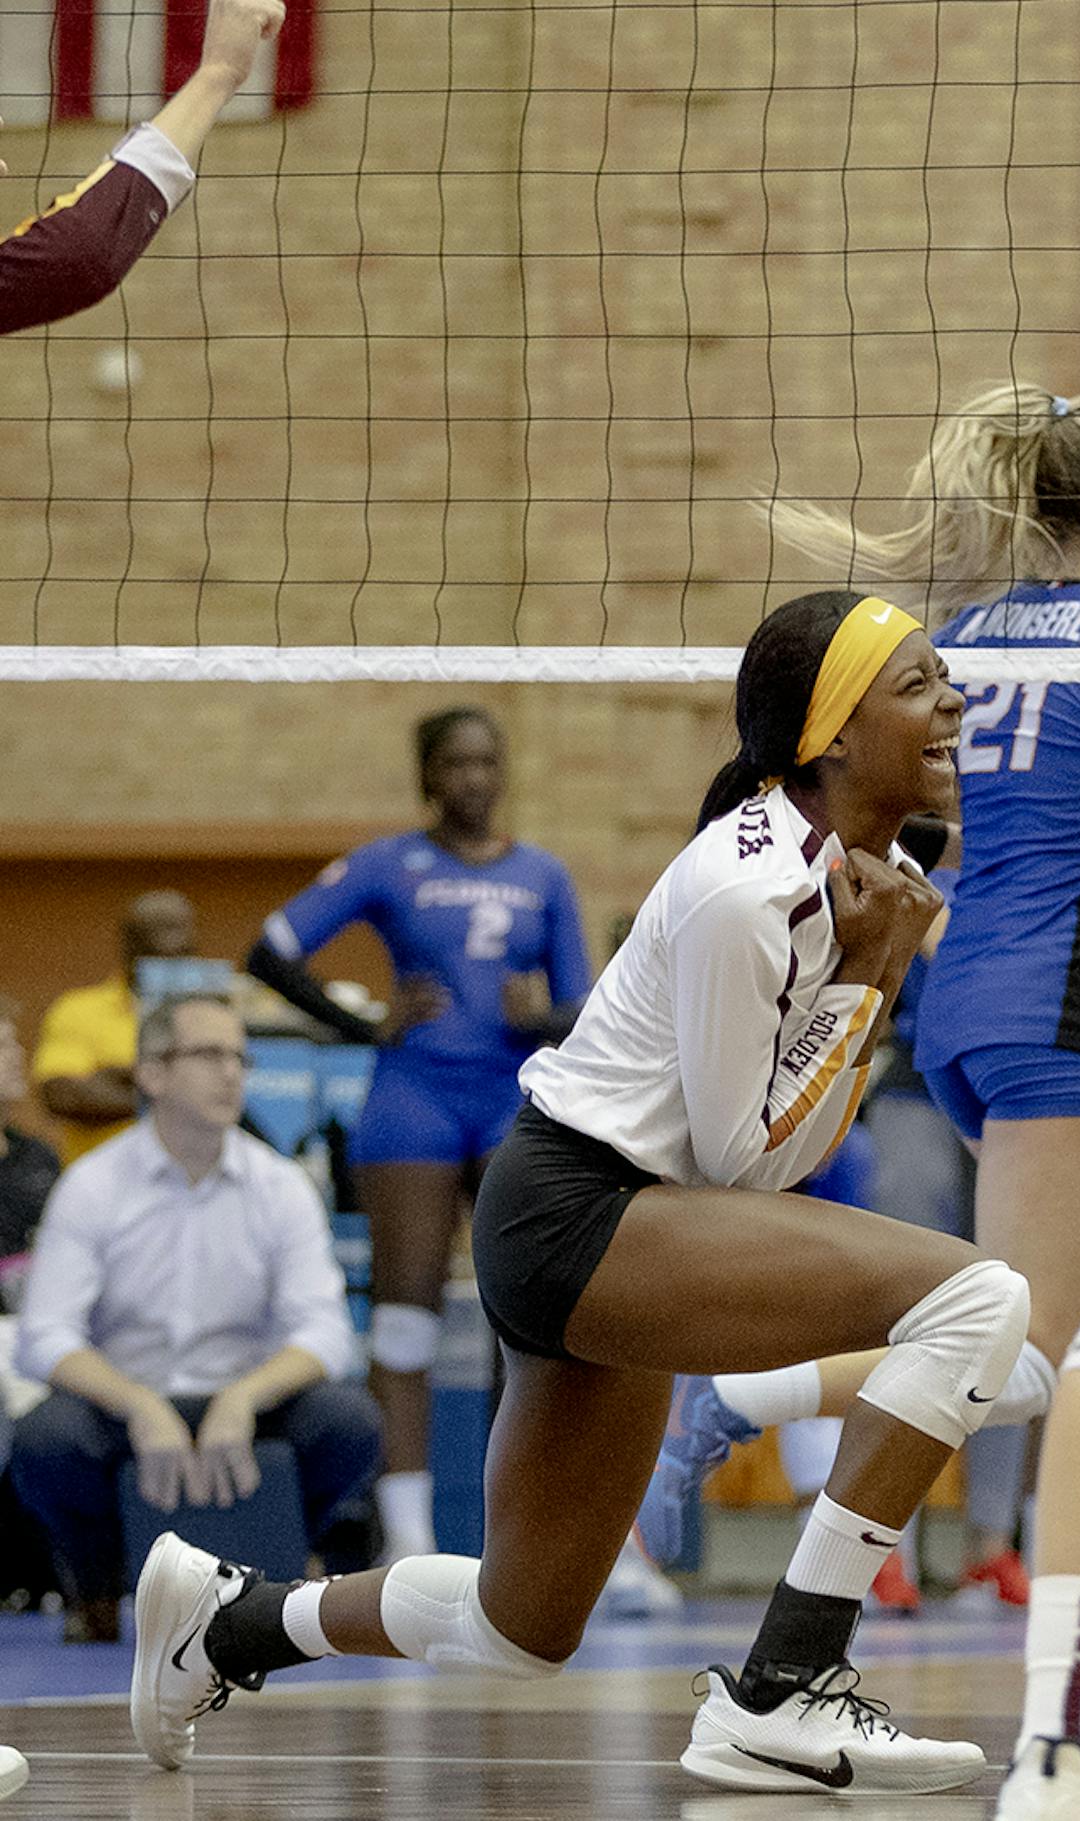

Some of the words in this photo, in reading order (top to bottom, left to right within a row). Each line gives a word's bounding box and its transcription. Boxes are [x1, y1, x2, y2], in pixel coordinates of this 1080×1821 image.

[957, 681, 1049, 775] 21
[464, 900, 514, 961] 2
[779, 1009, 838, 1077] GOLDEN
